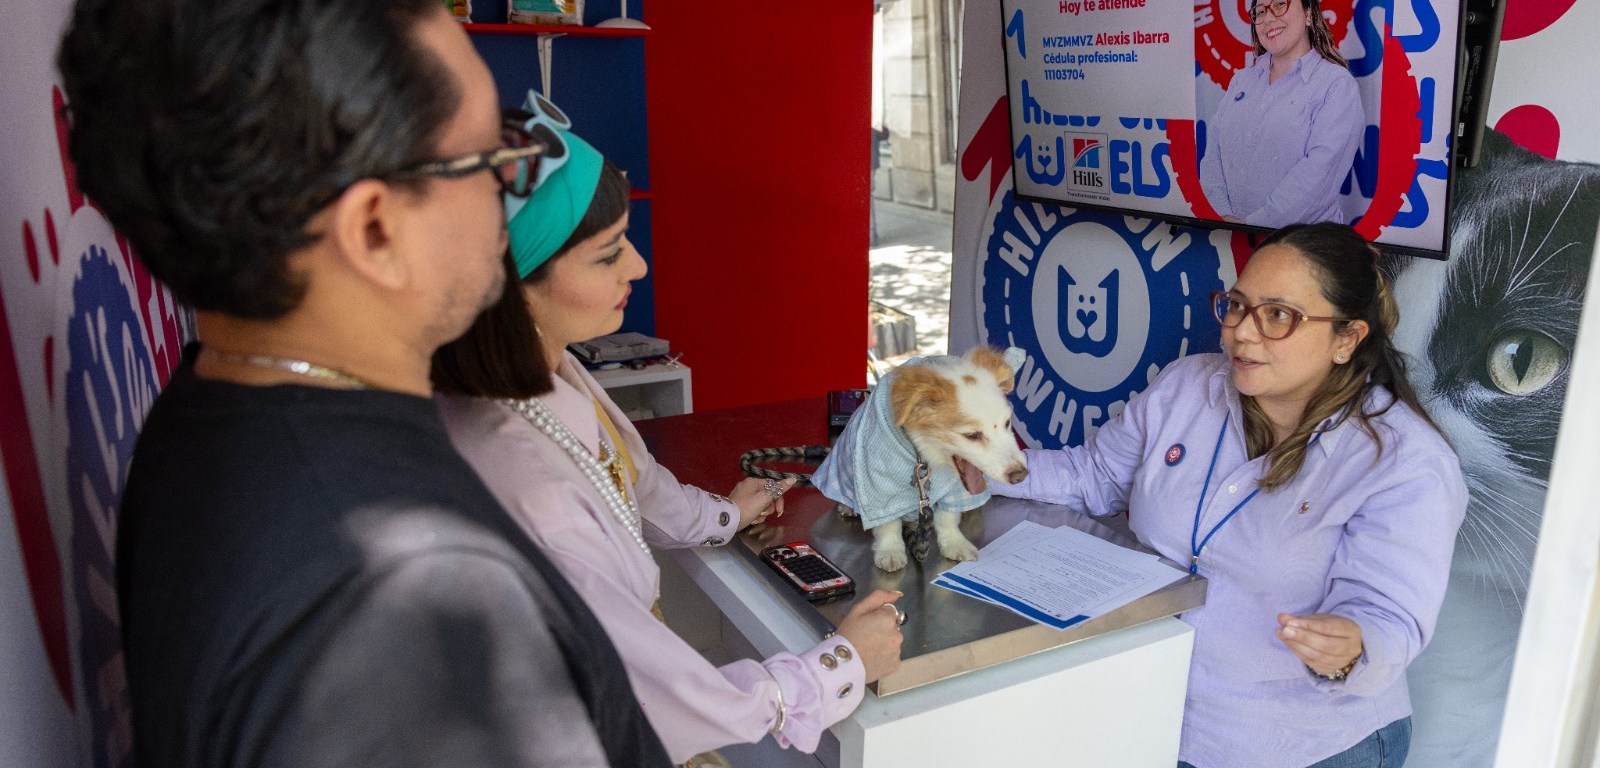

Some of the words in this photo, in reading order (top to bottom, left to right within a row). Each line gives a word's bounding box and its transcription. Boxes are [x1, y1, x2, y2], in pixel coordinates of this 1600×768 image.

[1059, 0, 1080, 16] Hoy
[1083, 0, 1096, 12] te
[1098, 0, 1146, 10] atiende
[1042, 36, 1094, 48] MVZMMVZ
[1095, 31, 1130, 46] Alexis
[1133, 31, 1170, 45] Ibarra
[1043, 53, 1076, 64] Cédula
[1077, 50, 1138, 66] profesional:
[1044, 69, 1085, 81] 11103704
[1073, 170, 1104, 188] Hill's
